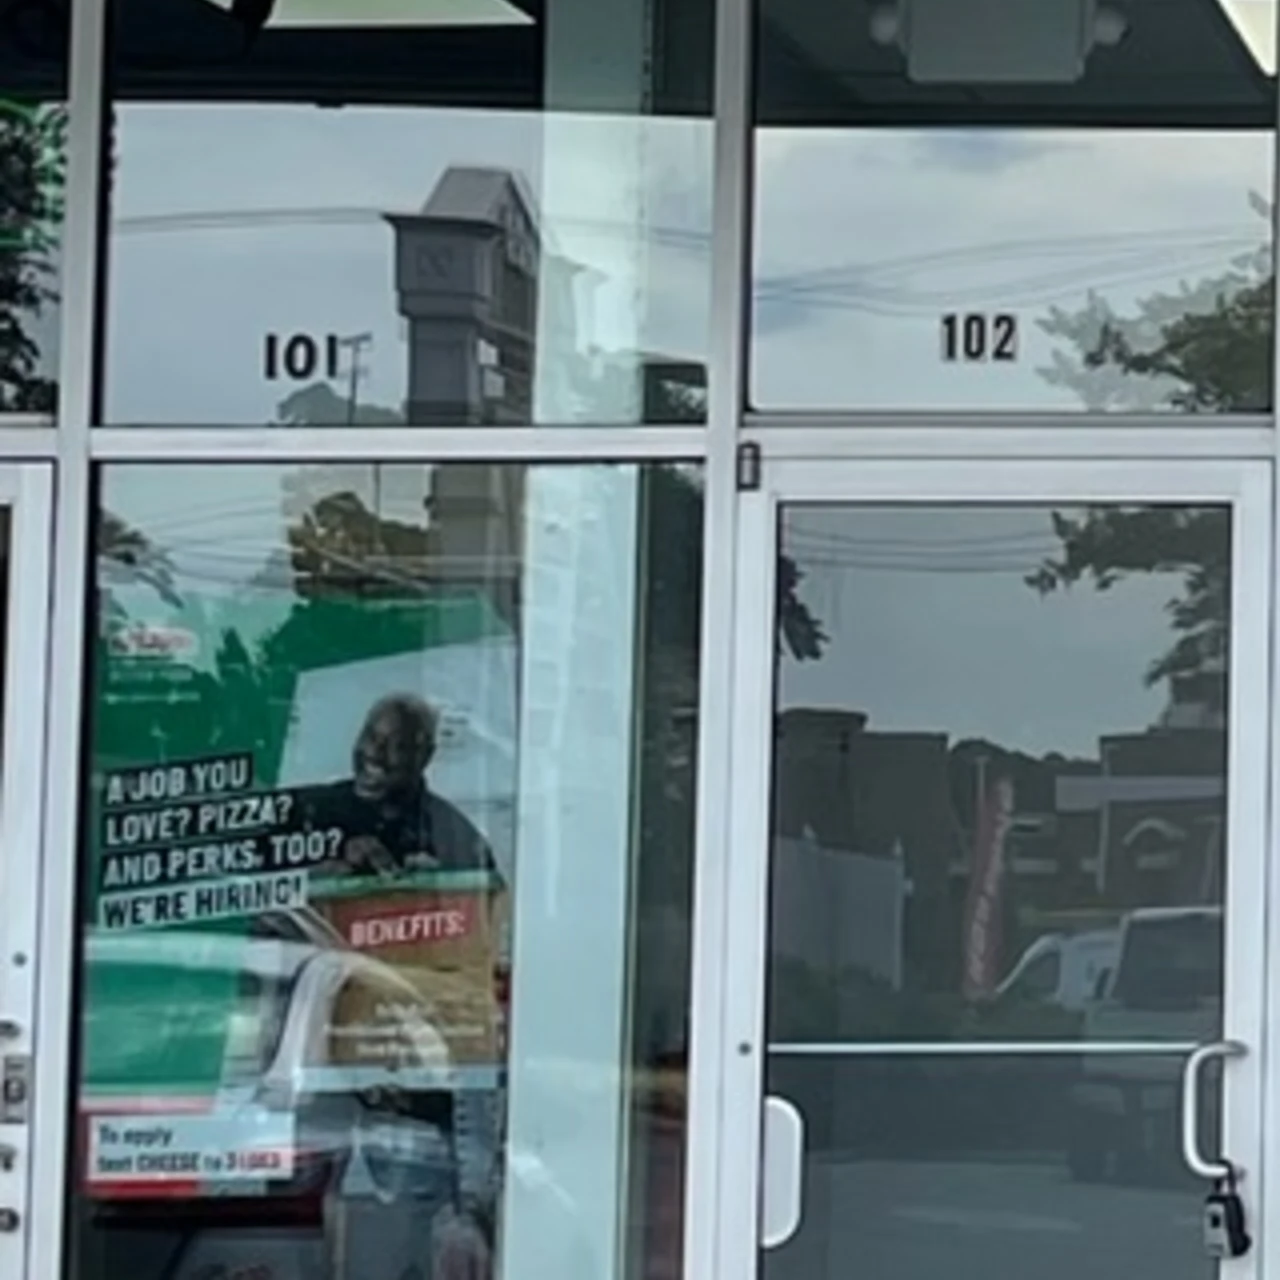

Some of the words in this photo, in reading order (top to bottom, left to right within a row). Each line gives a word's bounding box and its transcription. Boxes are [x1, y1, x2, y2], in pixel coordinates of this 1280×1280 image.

[265, 333, 337, 380] 101
[941, 313, 1016, 360] 102
[106, 774, 124, 805] A
[131, 767, 186, 801] JOB
[191, 758, 249, 791] YOU
[106, 807, 193, 845] LOVE?
[198, 794, 294, 833] PIZZA?
[103, 853, 162, 887] AND
[269, 827, 344, 864] TOO?
[103, 891, 188, 929] WE'RE
[195, 876, 302, 916] HIRING!
[99, 1124, 118, 1144] To
[123, 1126, 173, 1147] apply
[136, 1151, 199, 1171] CHEESE
